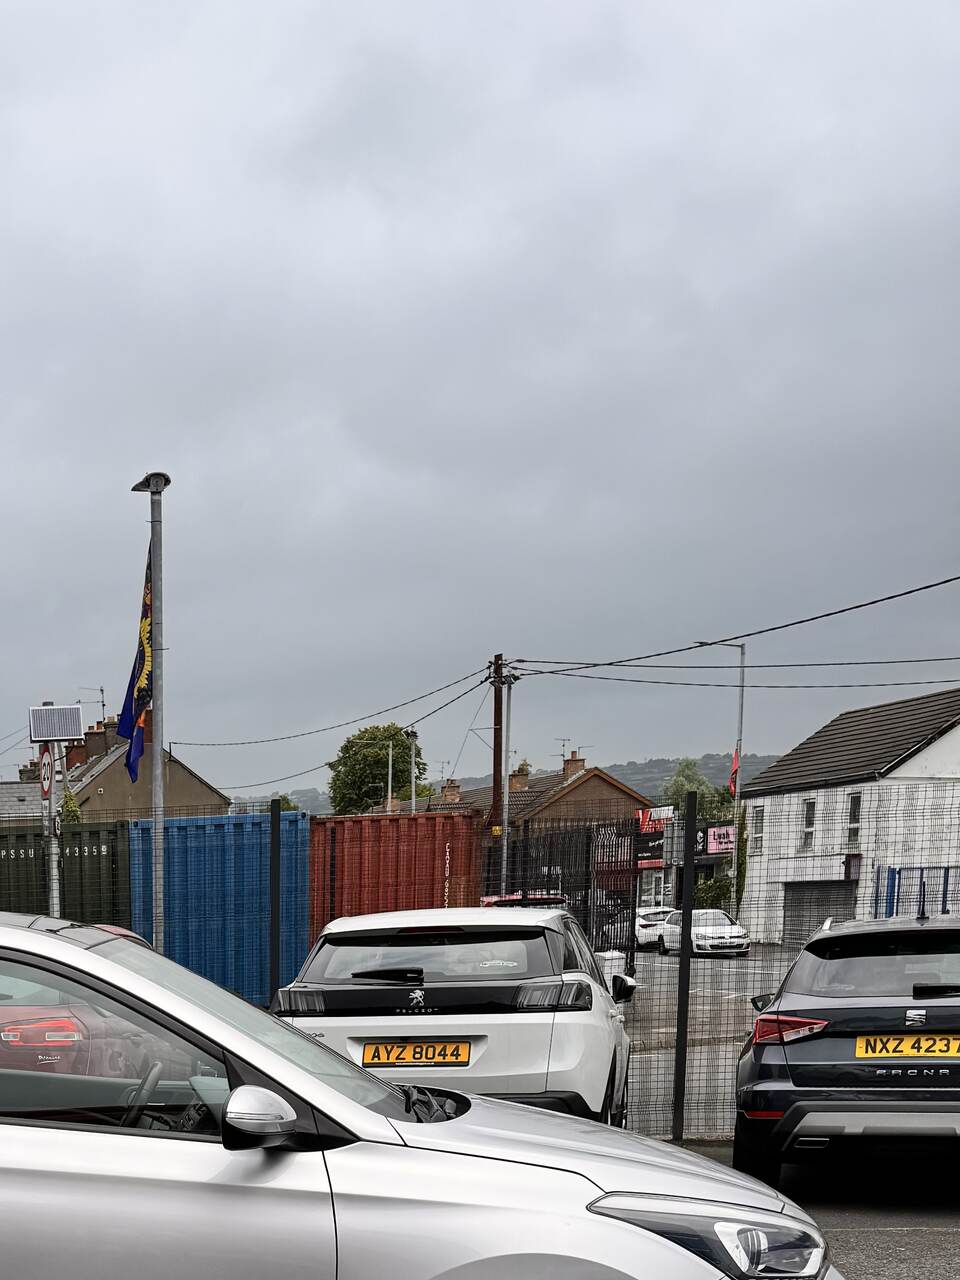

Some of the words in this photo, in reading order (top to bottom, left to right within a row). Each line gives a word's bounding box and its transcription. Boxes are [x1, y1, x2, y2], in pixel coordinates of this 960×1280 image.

[42, 762, 51, 782] 20
[1, 848, 34, 859] PSSU
[371, 1045, 407, 1061] AYZ
[412, 1044, 461, 1060] 8044
[865, 1038, 904, 1054] NXZ
